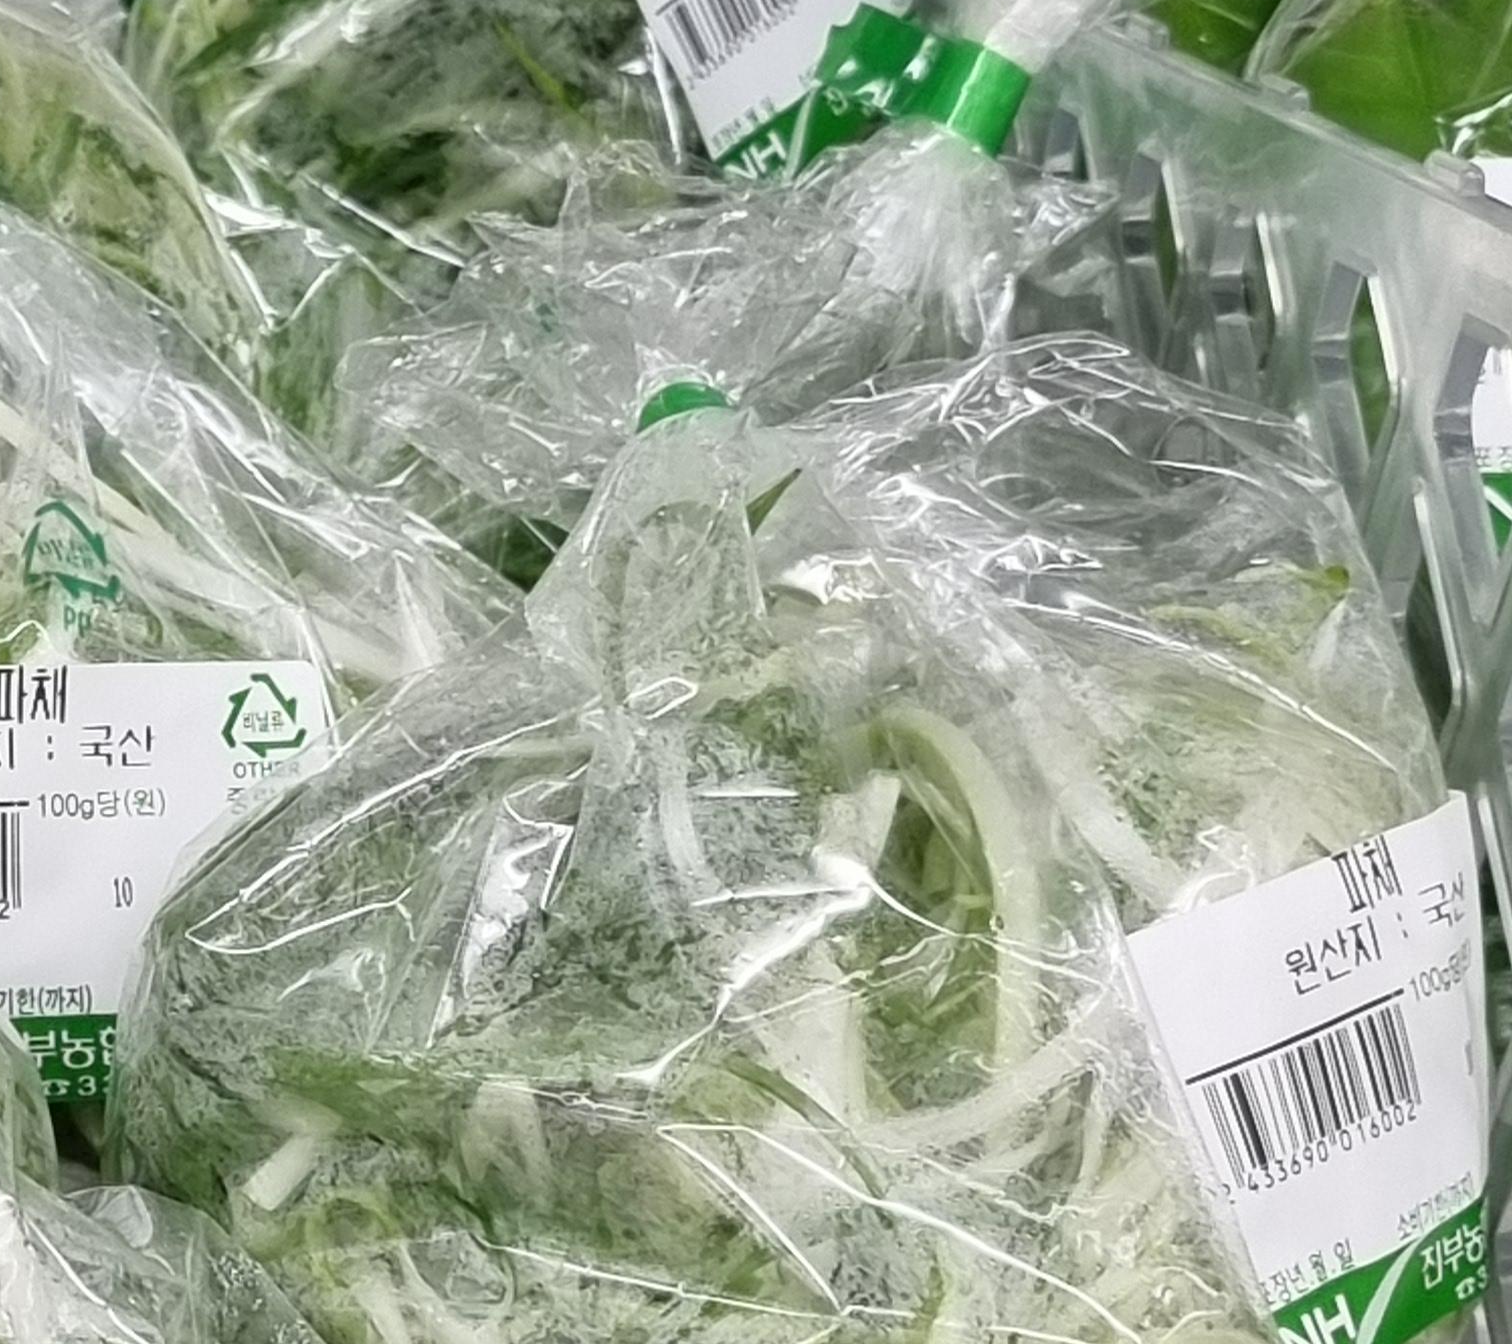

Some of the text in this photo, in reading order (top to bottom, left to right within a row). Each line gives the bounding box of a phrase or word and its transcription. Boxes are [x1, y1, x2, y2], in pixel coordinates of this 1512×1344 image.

[80, 725, 155, 767] 국산
[38, 788, 167, 819] 100g당(원)
[113, 875, 134, 908] 10
[1332, 834, 1403, 914] 파채
[1286, 915, 1383, 995] 원산지
